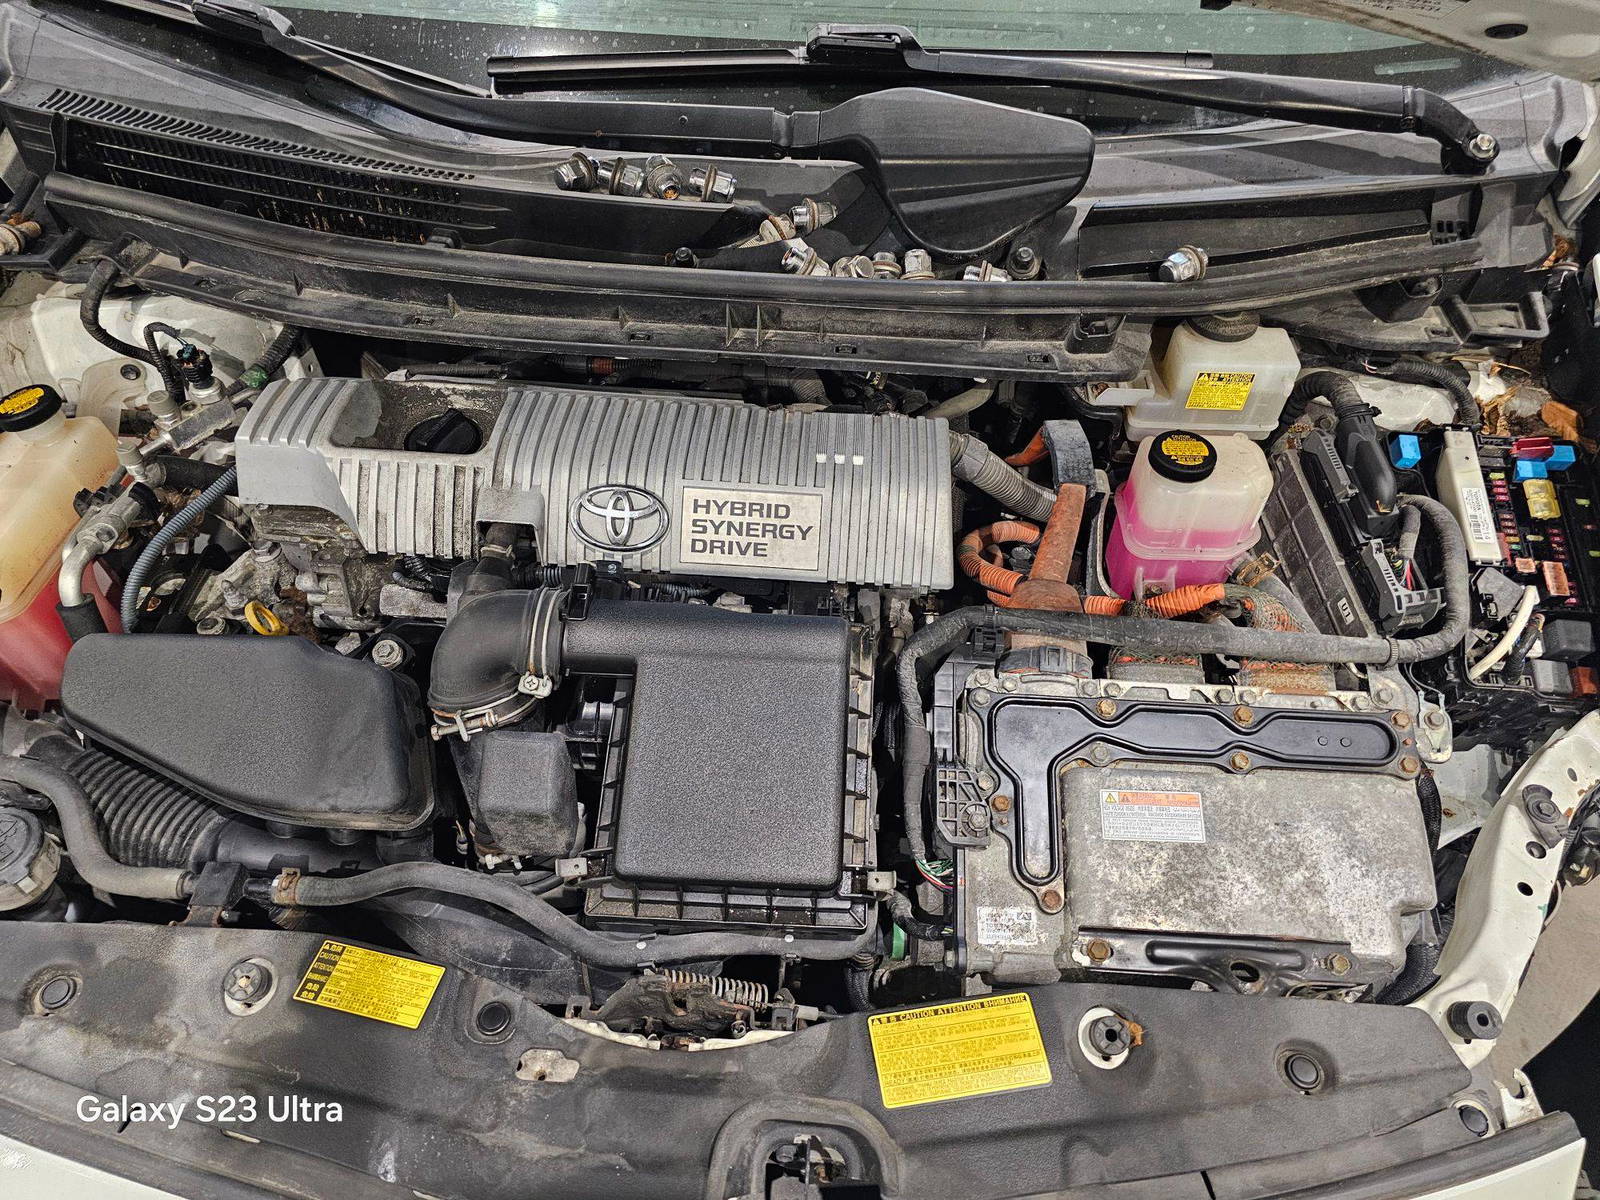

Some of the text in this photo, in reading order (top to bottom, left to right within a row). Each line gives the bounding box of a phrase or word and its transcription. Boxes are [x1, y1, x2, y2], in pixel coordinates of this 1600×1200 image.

[693, 499, 791, 519] HYBRID
[692, 519, 814, 540] SYNERGY
[691, 538, 768, 557] DRIVE
[319, 951, 340, 961] CAUTION
[900, 1008, 934, 1020] CAUTION
[938, 1003, 981, 1015] ATTENTION
